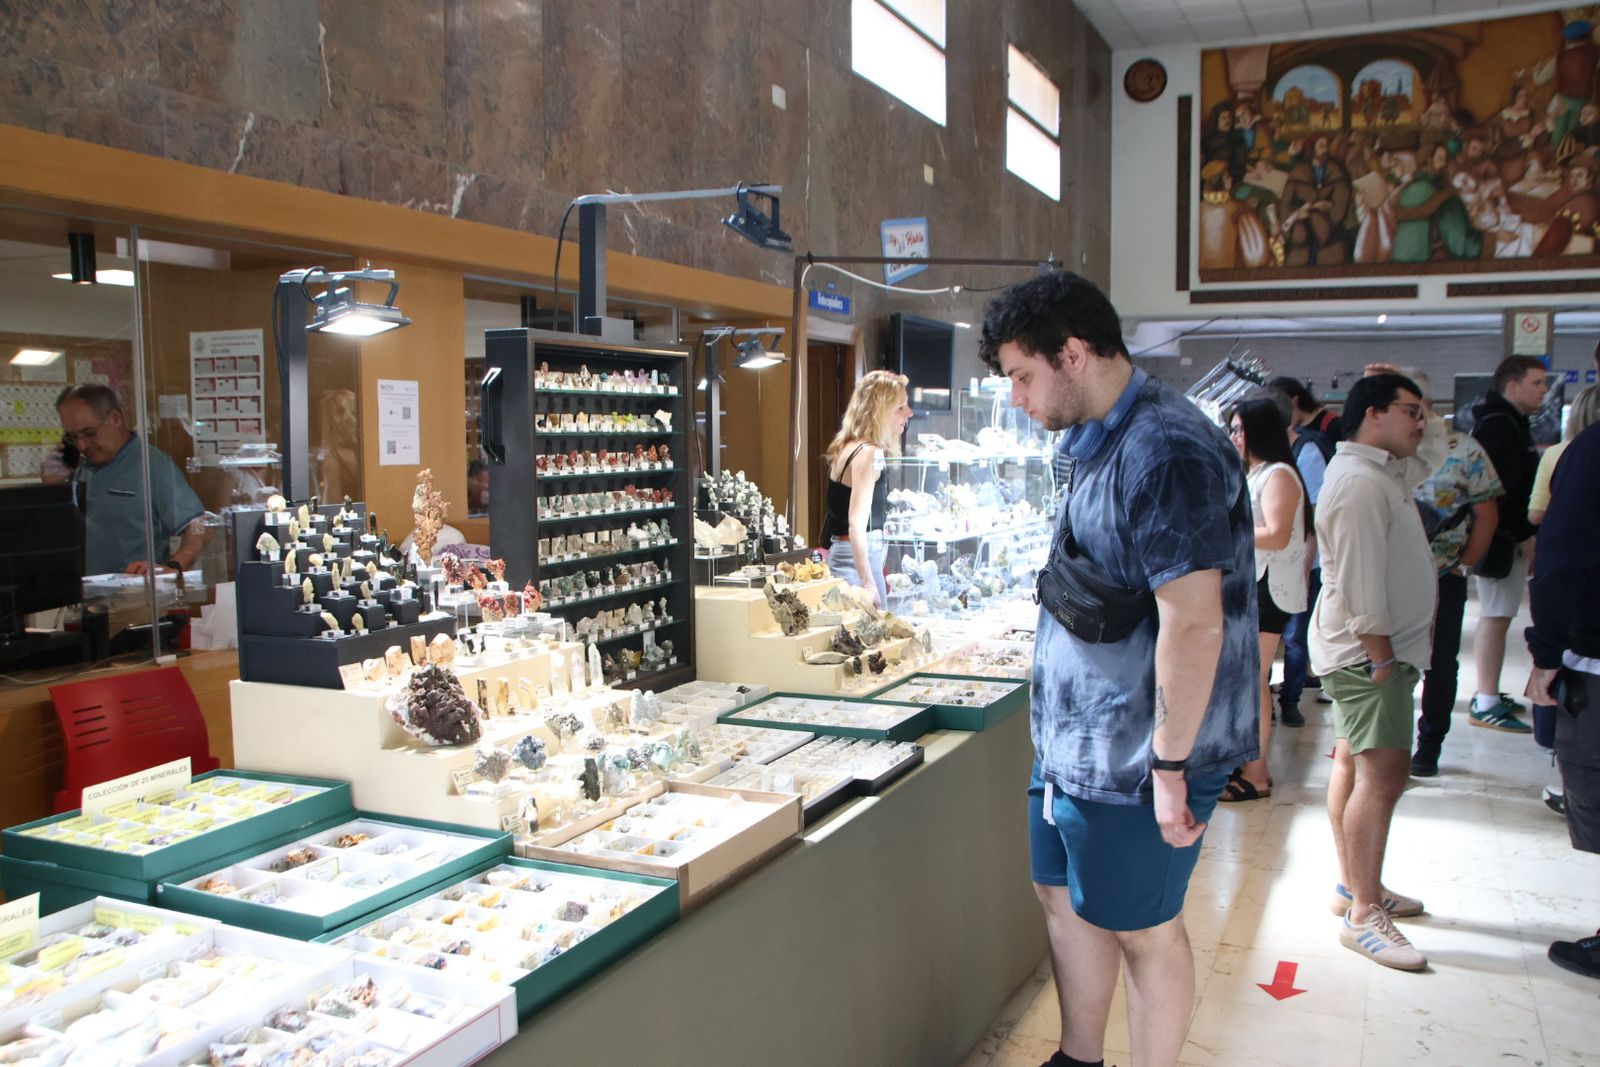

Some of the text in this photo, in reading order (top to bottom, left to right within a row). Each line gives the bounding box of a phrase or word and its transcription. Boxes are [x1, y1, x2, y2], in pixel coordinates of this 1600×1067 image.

[130, 778, 140, 788] DE
[141, 776, 149, 785] 25
[150, 765, 188, 781] MINERALES
